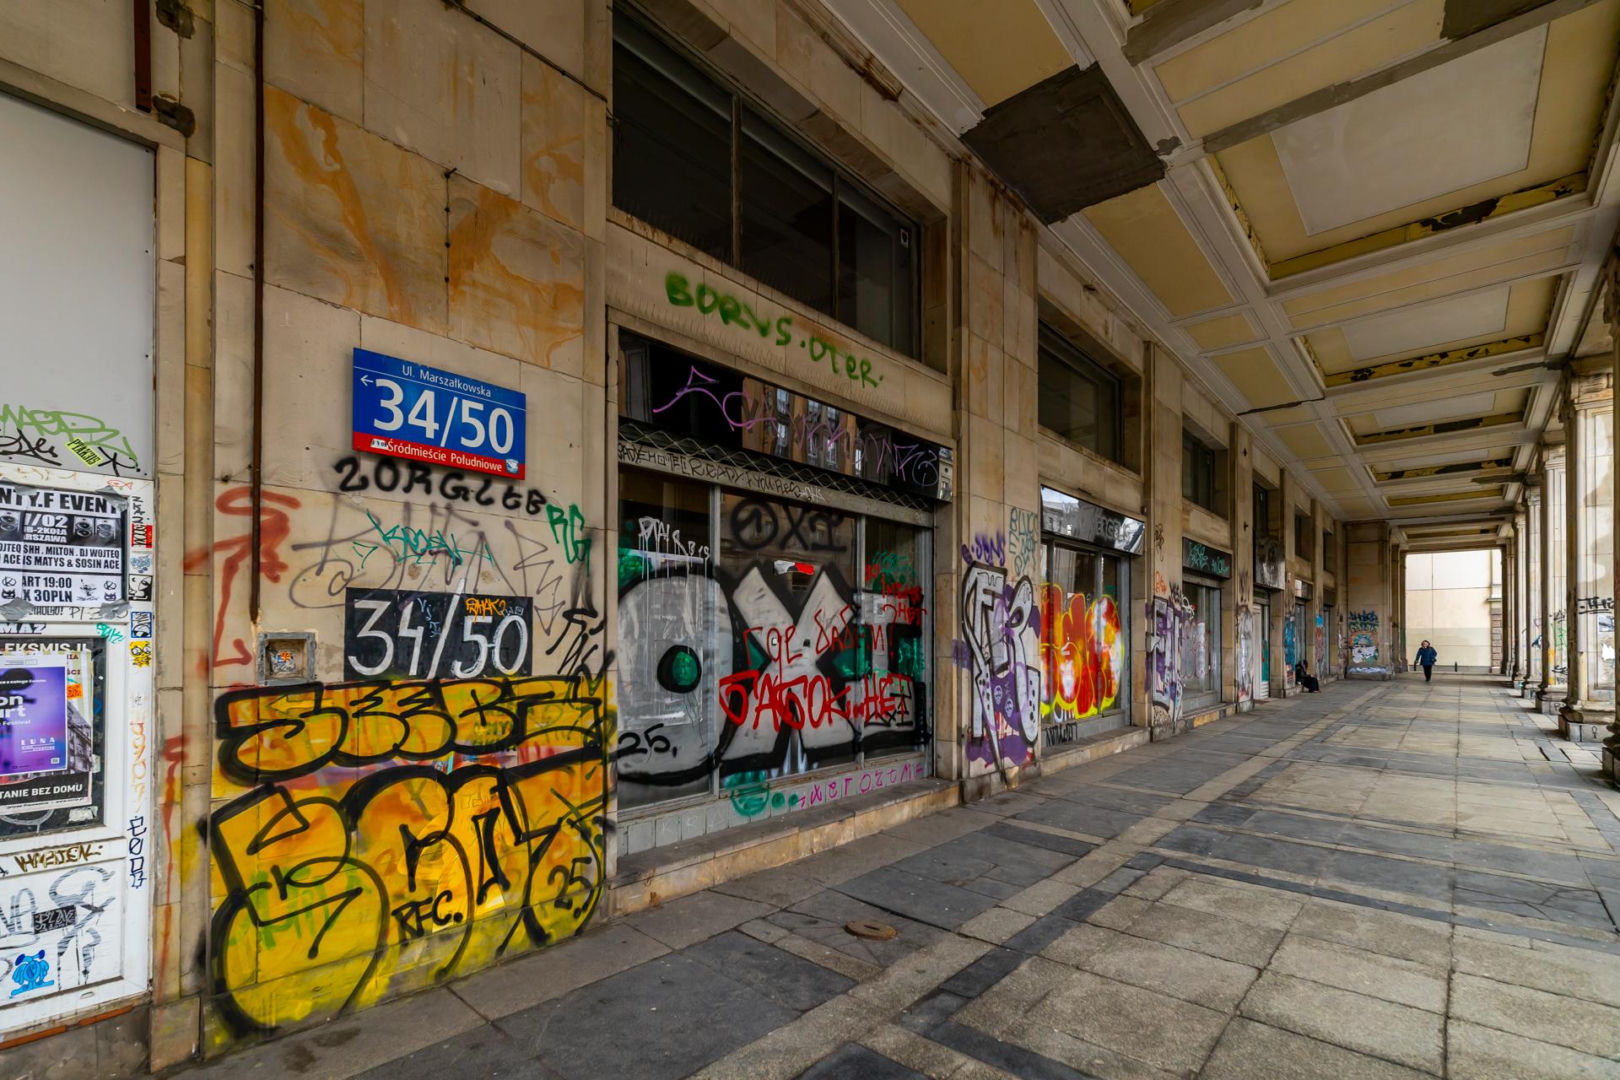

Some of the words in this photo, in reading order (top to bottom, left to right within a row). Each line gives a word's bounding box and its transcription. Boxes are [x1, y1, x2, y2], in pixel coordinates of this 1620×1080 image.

[419, 369, 492, 398] Marszałkowska
[373, 378, 515, 454] 34/50
[386, 438, 447, 462] Śródmieście
[450, 452, 503, 473] Południowe
[45, 546, 75, 557] MILTON
[90, 550, 120, 559] WOJTEQ
[34, 556, 65, 567] MATYS
[75, 558, 102, 569] SOSIN
[103, 560, 120, 570] ACE
[42, 576, 72, 589] 19:00
[34, 589, 73, 603] 30PLN
[347, 575, 529, 681] 34/50
[32, 787, 51, 796] BEZ
[53, 783, 83, 794] DOMU
